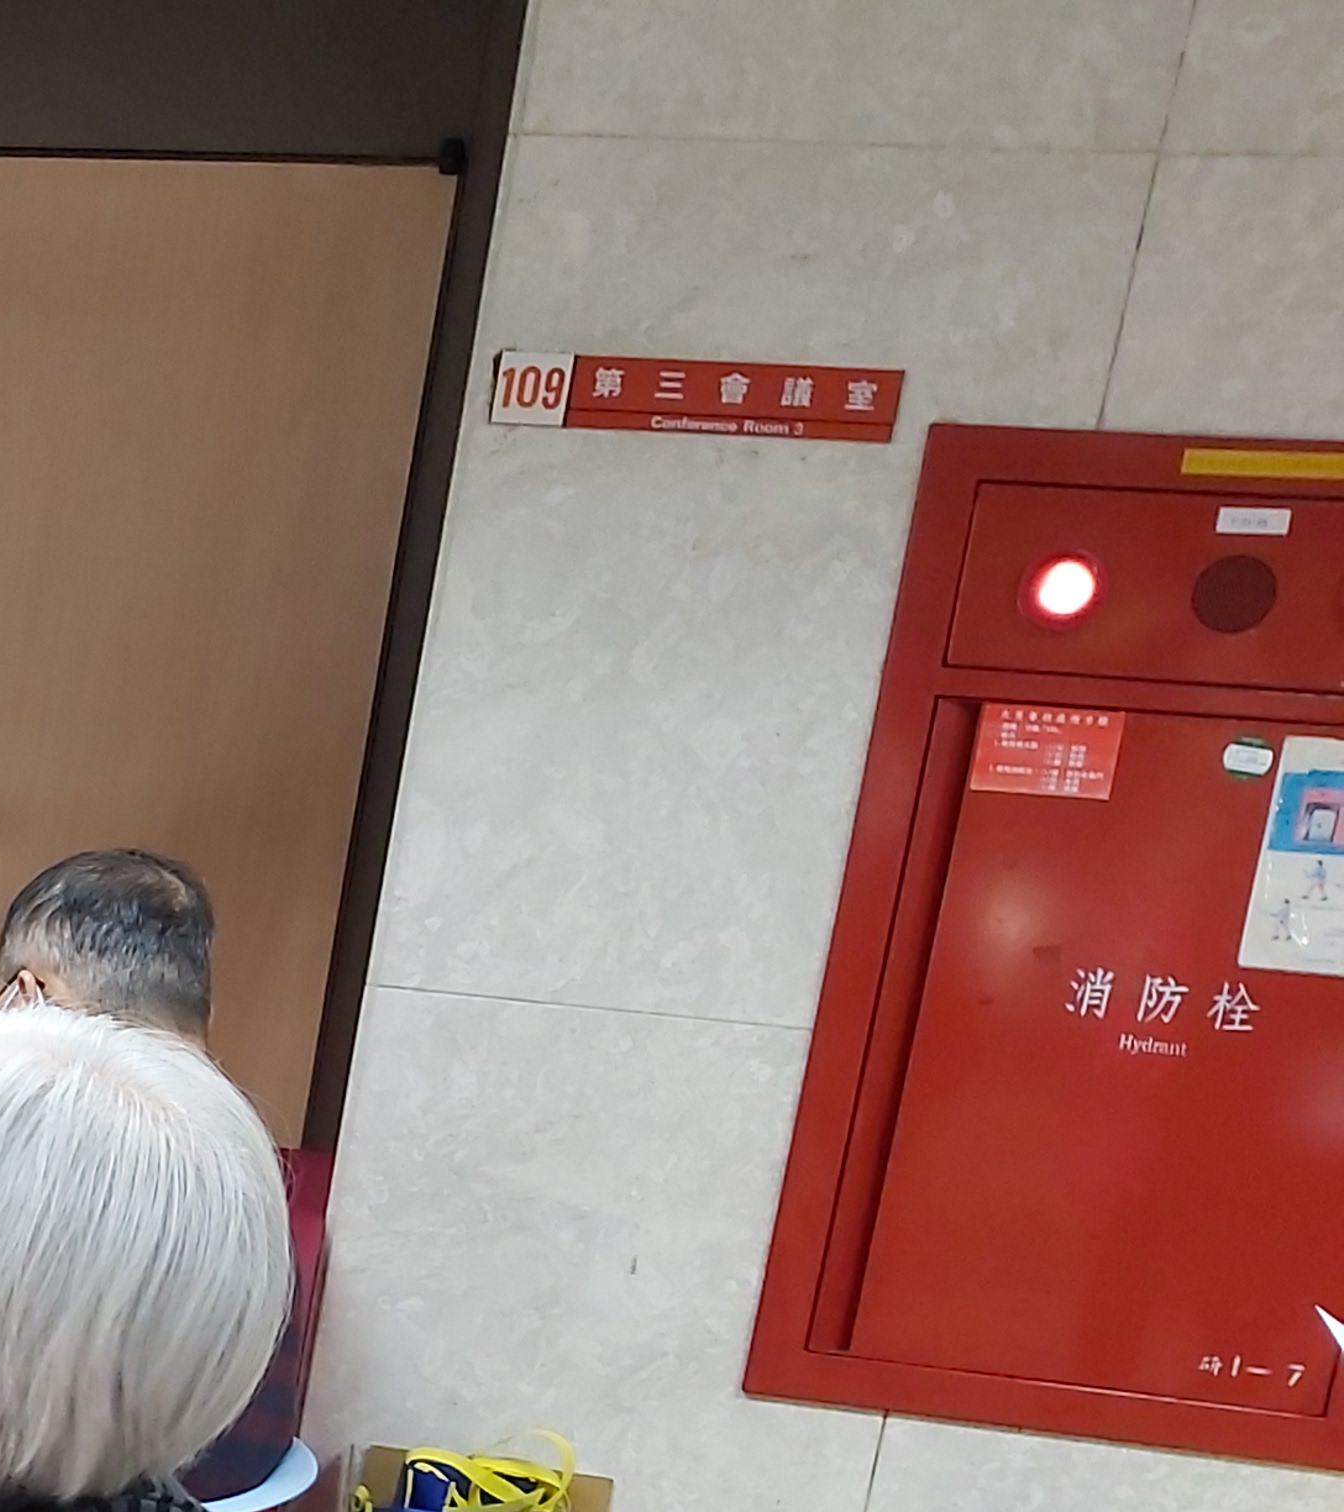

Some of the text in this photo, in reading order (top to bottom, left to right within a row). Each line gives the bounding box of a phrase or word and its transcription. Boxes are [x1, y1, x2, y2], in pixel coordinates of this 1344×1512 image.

[500, 365, 878, 412] 109 第三會議室
[650, 415, 739, 434] Conference
[742, 420, 789, 435] Room
[1064, 967, 1261, 1031] 消防栓
[1118, 1033, 1188, 1056] Hydrant
